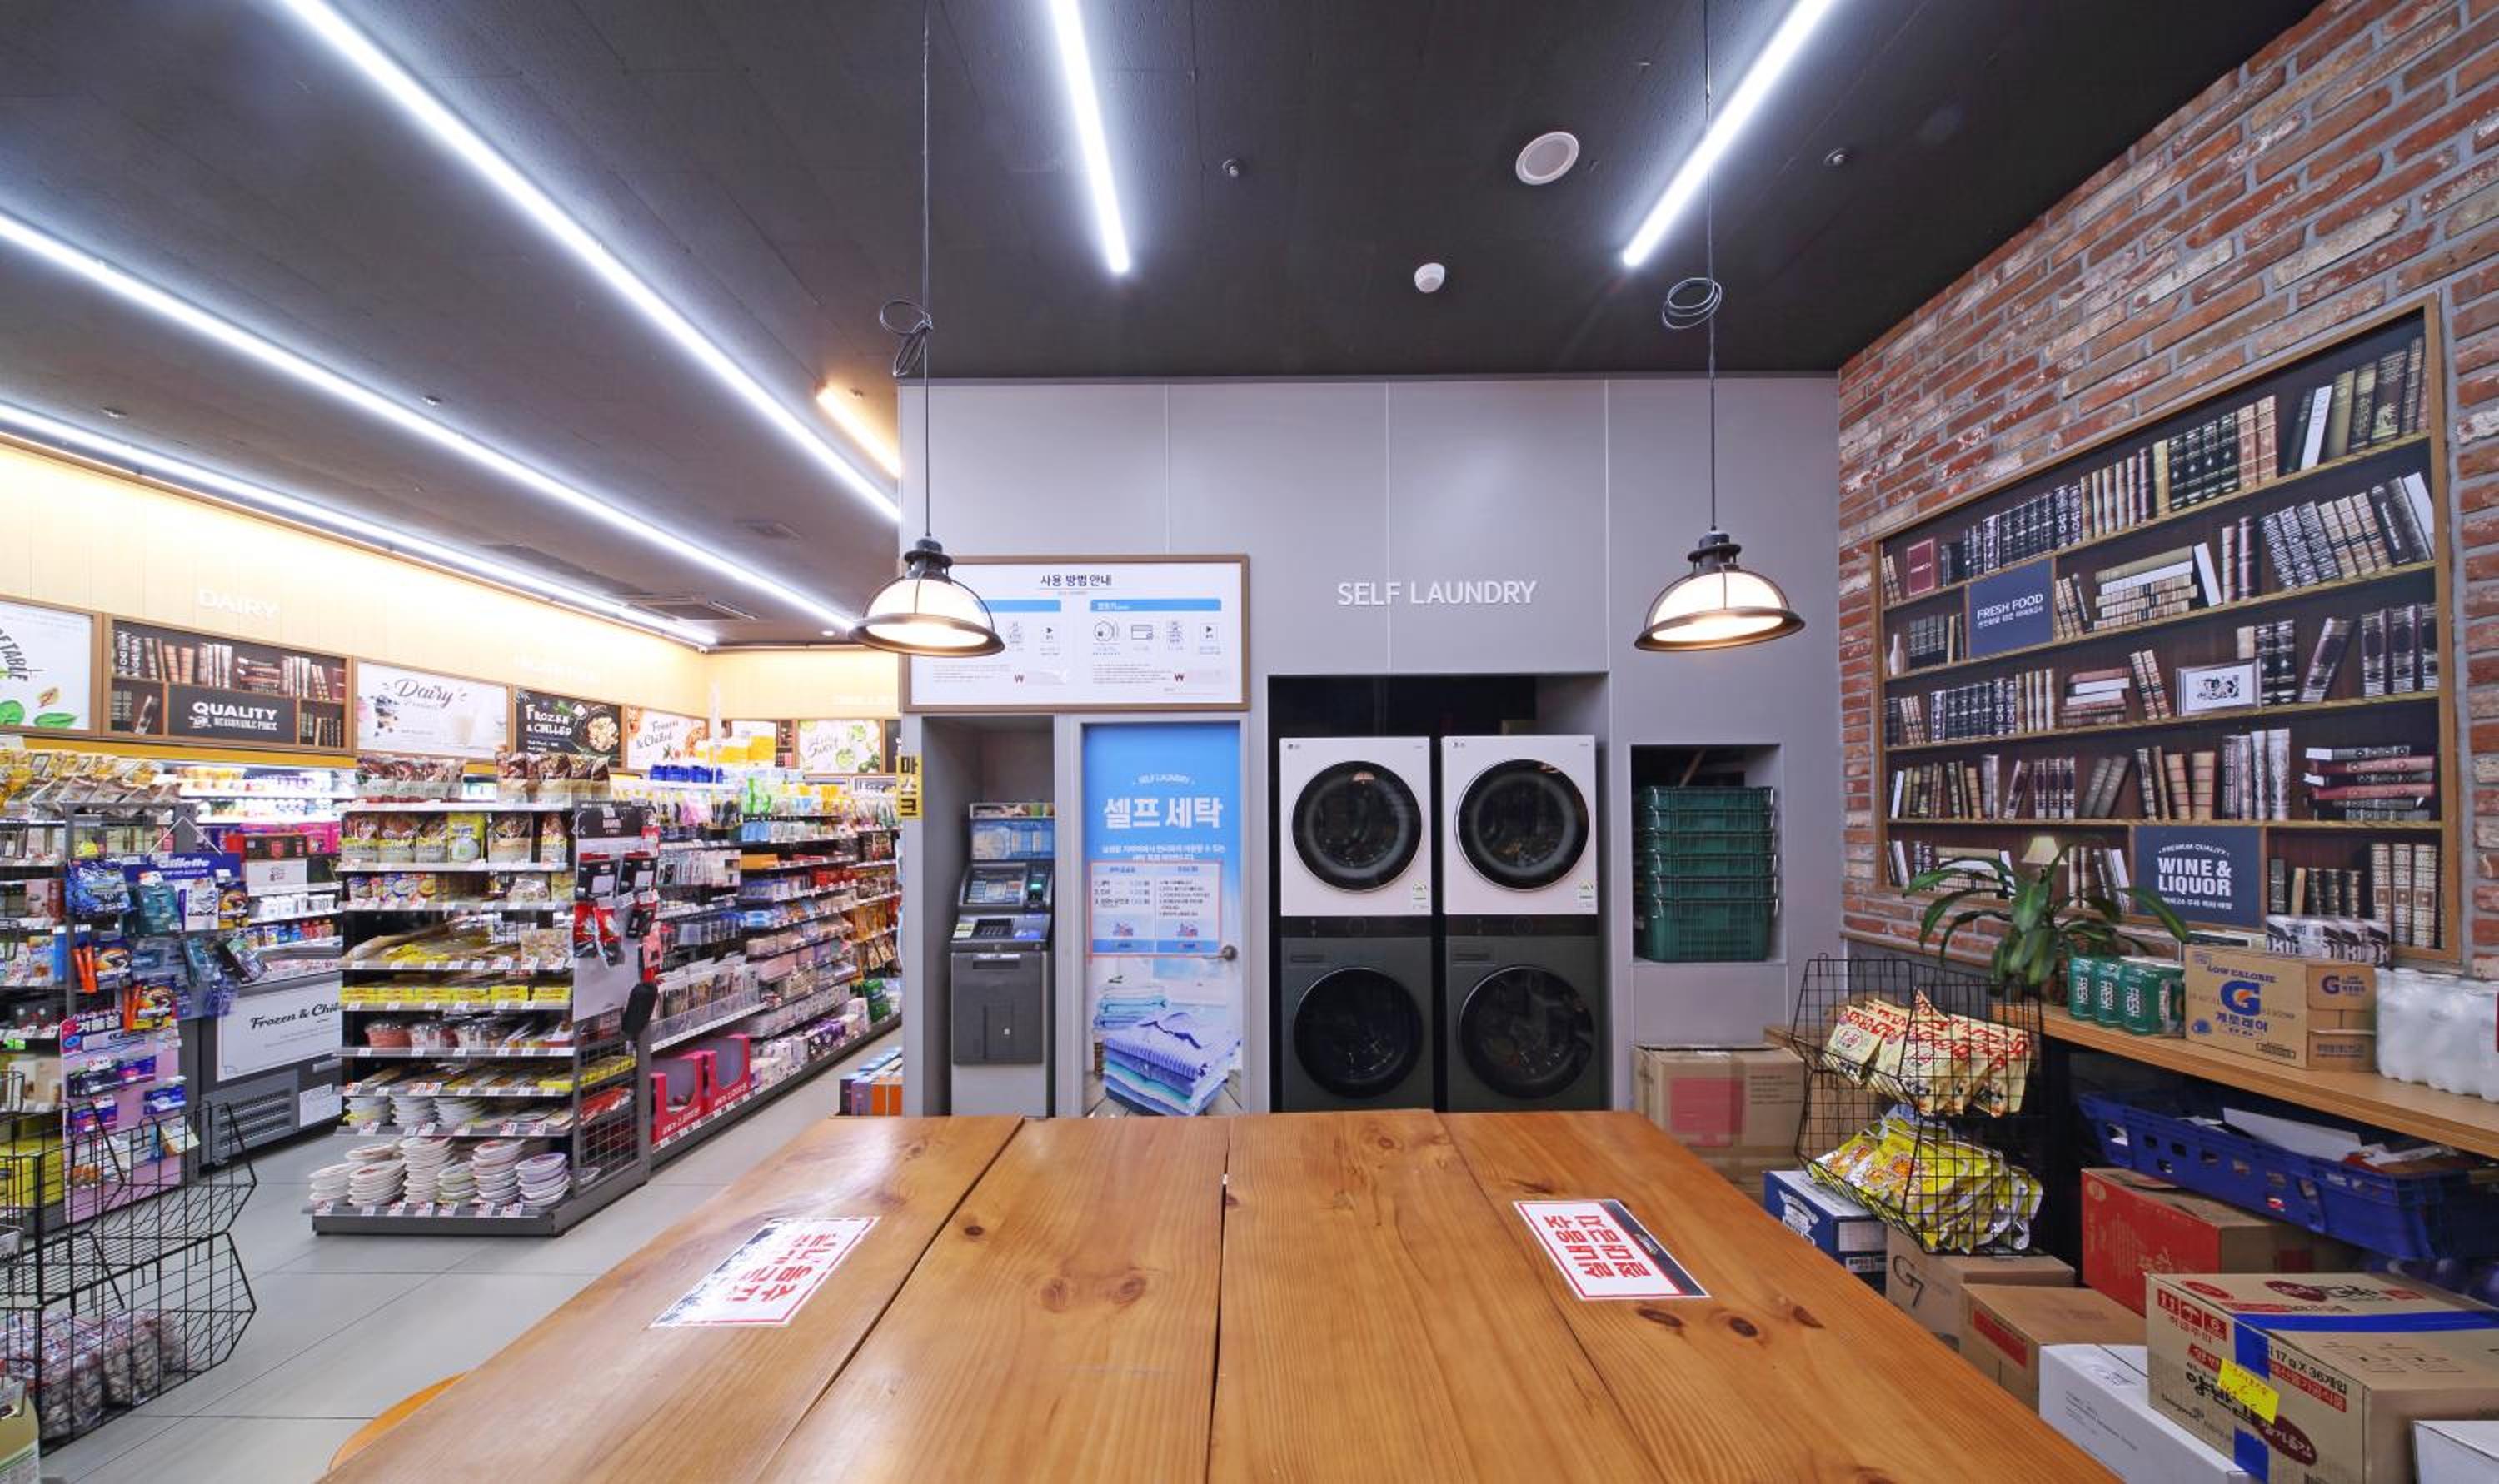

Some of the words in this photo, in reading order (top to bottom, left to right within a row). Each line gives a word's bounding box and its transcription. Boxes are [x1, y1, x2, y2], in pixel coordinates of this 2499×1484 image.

[1040, 575, 1062, 586] 사용
[1065, 575, 1088, 586] 방법
[1089, 574, 1112, 586] 안내
[1336, 580, 1402, 606] SELF
[1409, 579, 1538, 605] LAUNDRY
[200, 588, 280, 620] DAIRY
[1977, 602, 2010, 620] FRESH
[2012, 594, 2043, 610] FOOD
[394, 678, 454, 709] Dairy
[192, 702, 278, 720] QUALITY
[534, 723, 572, 735] CHILLED
[900, 755, 919, 816] 마스크
[1104, 798, 1160, 829] 셀프
[1165, 797, 1224, 829] 세탁
[2195, 844, 2227, 855] QUALITY
[2157, 857, 2212, 876] WINE
[2216, 860, 2232, 879] &
[2158, 874, 2232, 897] LIQUOR
[2207, 965, 2230, 975] LOW
[2231, 969, 2277, 984] CALORIE
[2322, 975, 2340, 994] G
[2220, 980, 2262, 1017] G
[250, 1014, 297, 1030] Frozen
[299, 1008, 310, 1018] &
[311, 1002, 340, 1017] Chil
[2216, 1012, 2268, 1032] 게토레이
[1544, 1215, 1615, 1279] 실내음주
[1574, 1215, 1652, 1279] 절대금지
